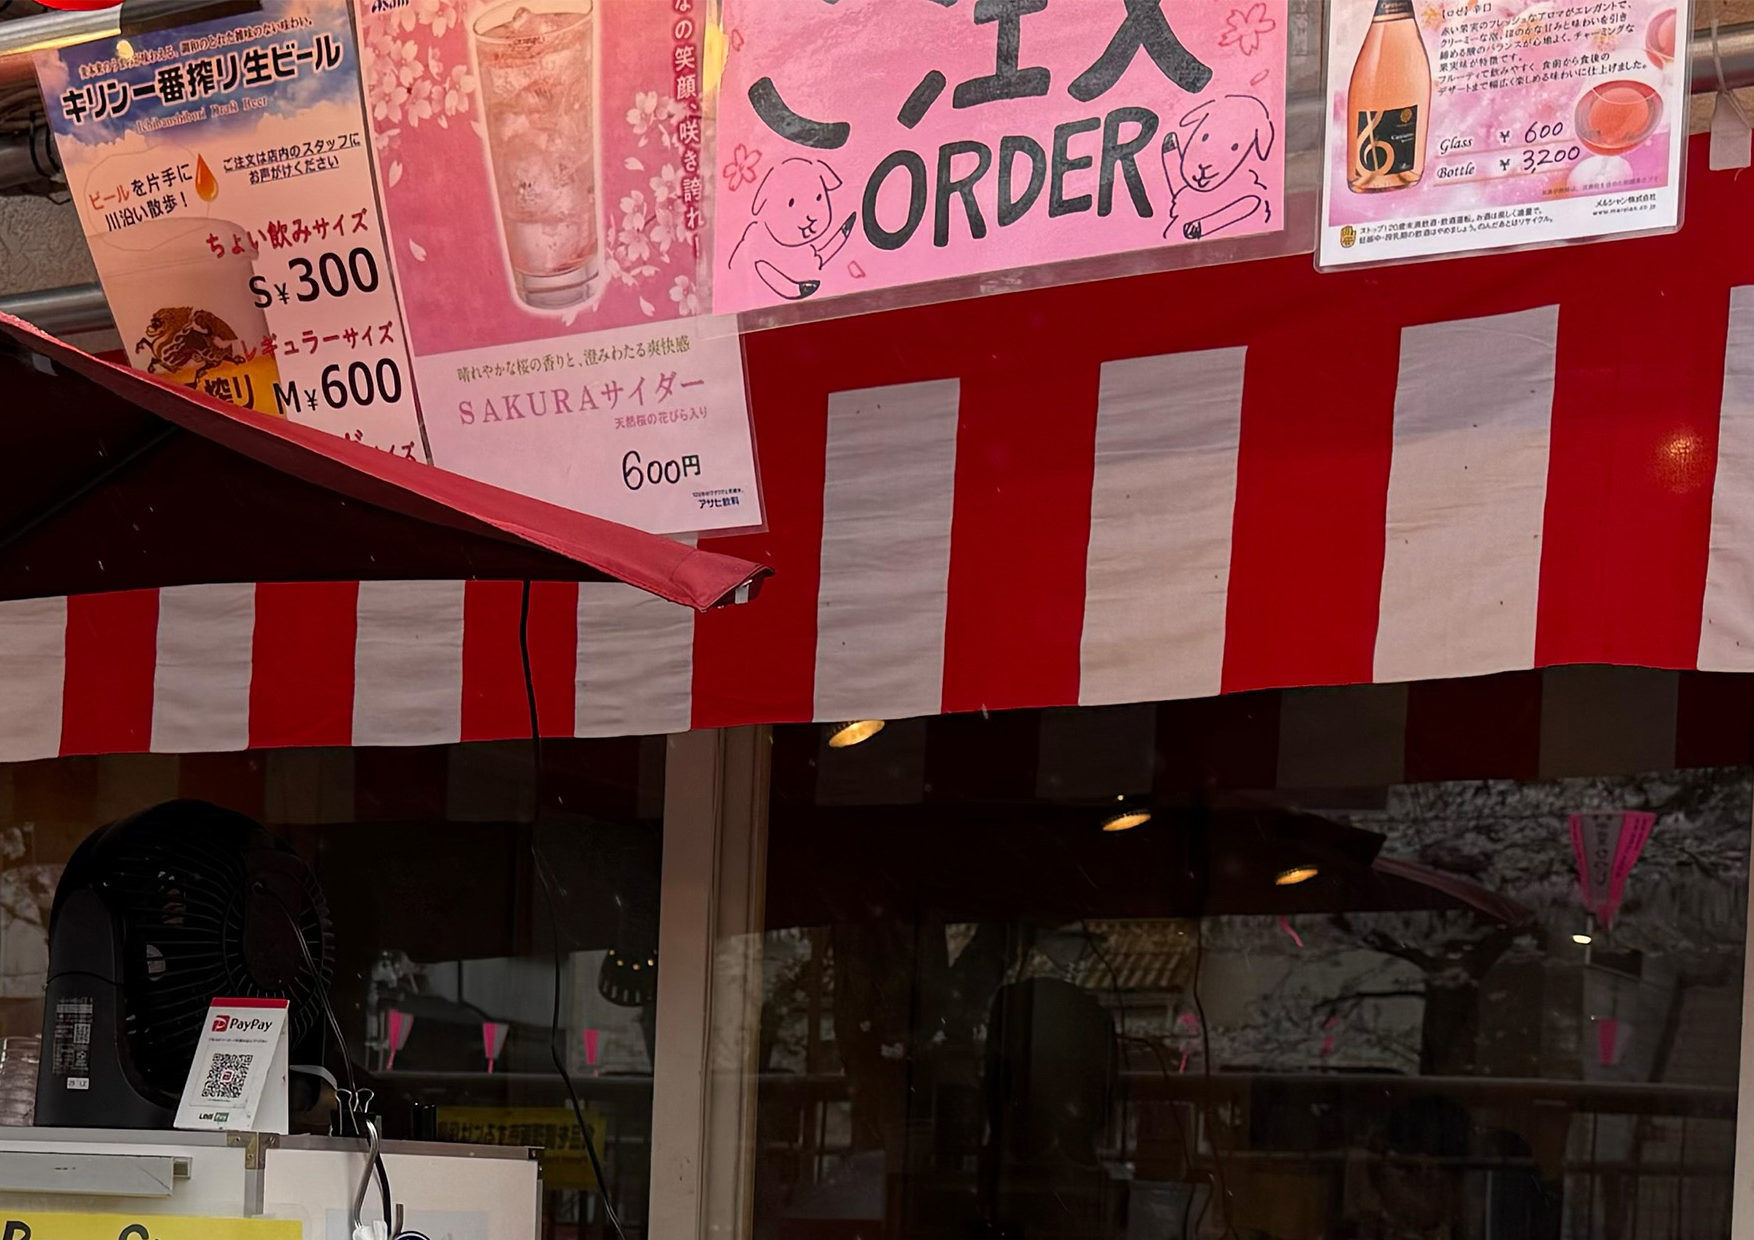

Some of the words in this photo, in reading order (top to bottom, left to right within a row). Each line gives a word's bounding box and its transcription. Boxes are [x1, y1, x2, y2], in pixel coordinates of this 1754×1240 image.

[1440, 136, 1473, 155] Glass
[862, 106, 1159, 250] ORDER
[1437, 163, 1475, 180] Bottle
[206, 208, 368, 258] ちょい飲みサイズ
[242, 320, 394, 361] レギュラーサイズ
[622, 450, 700, 490] 600円
[230, 1018, 272, 1032] PayPay
